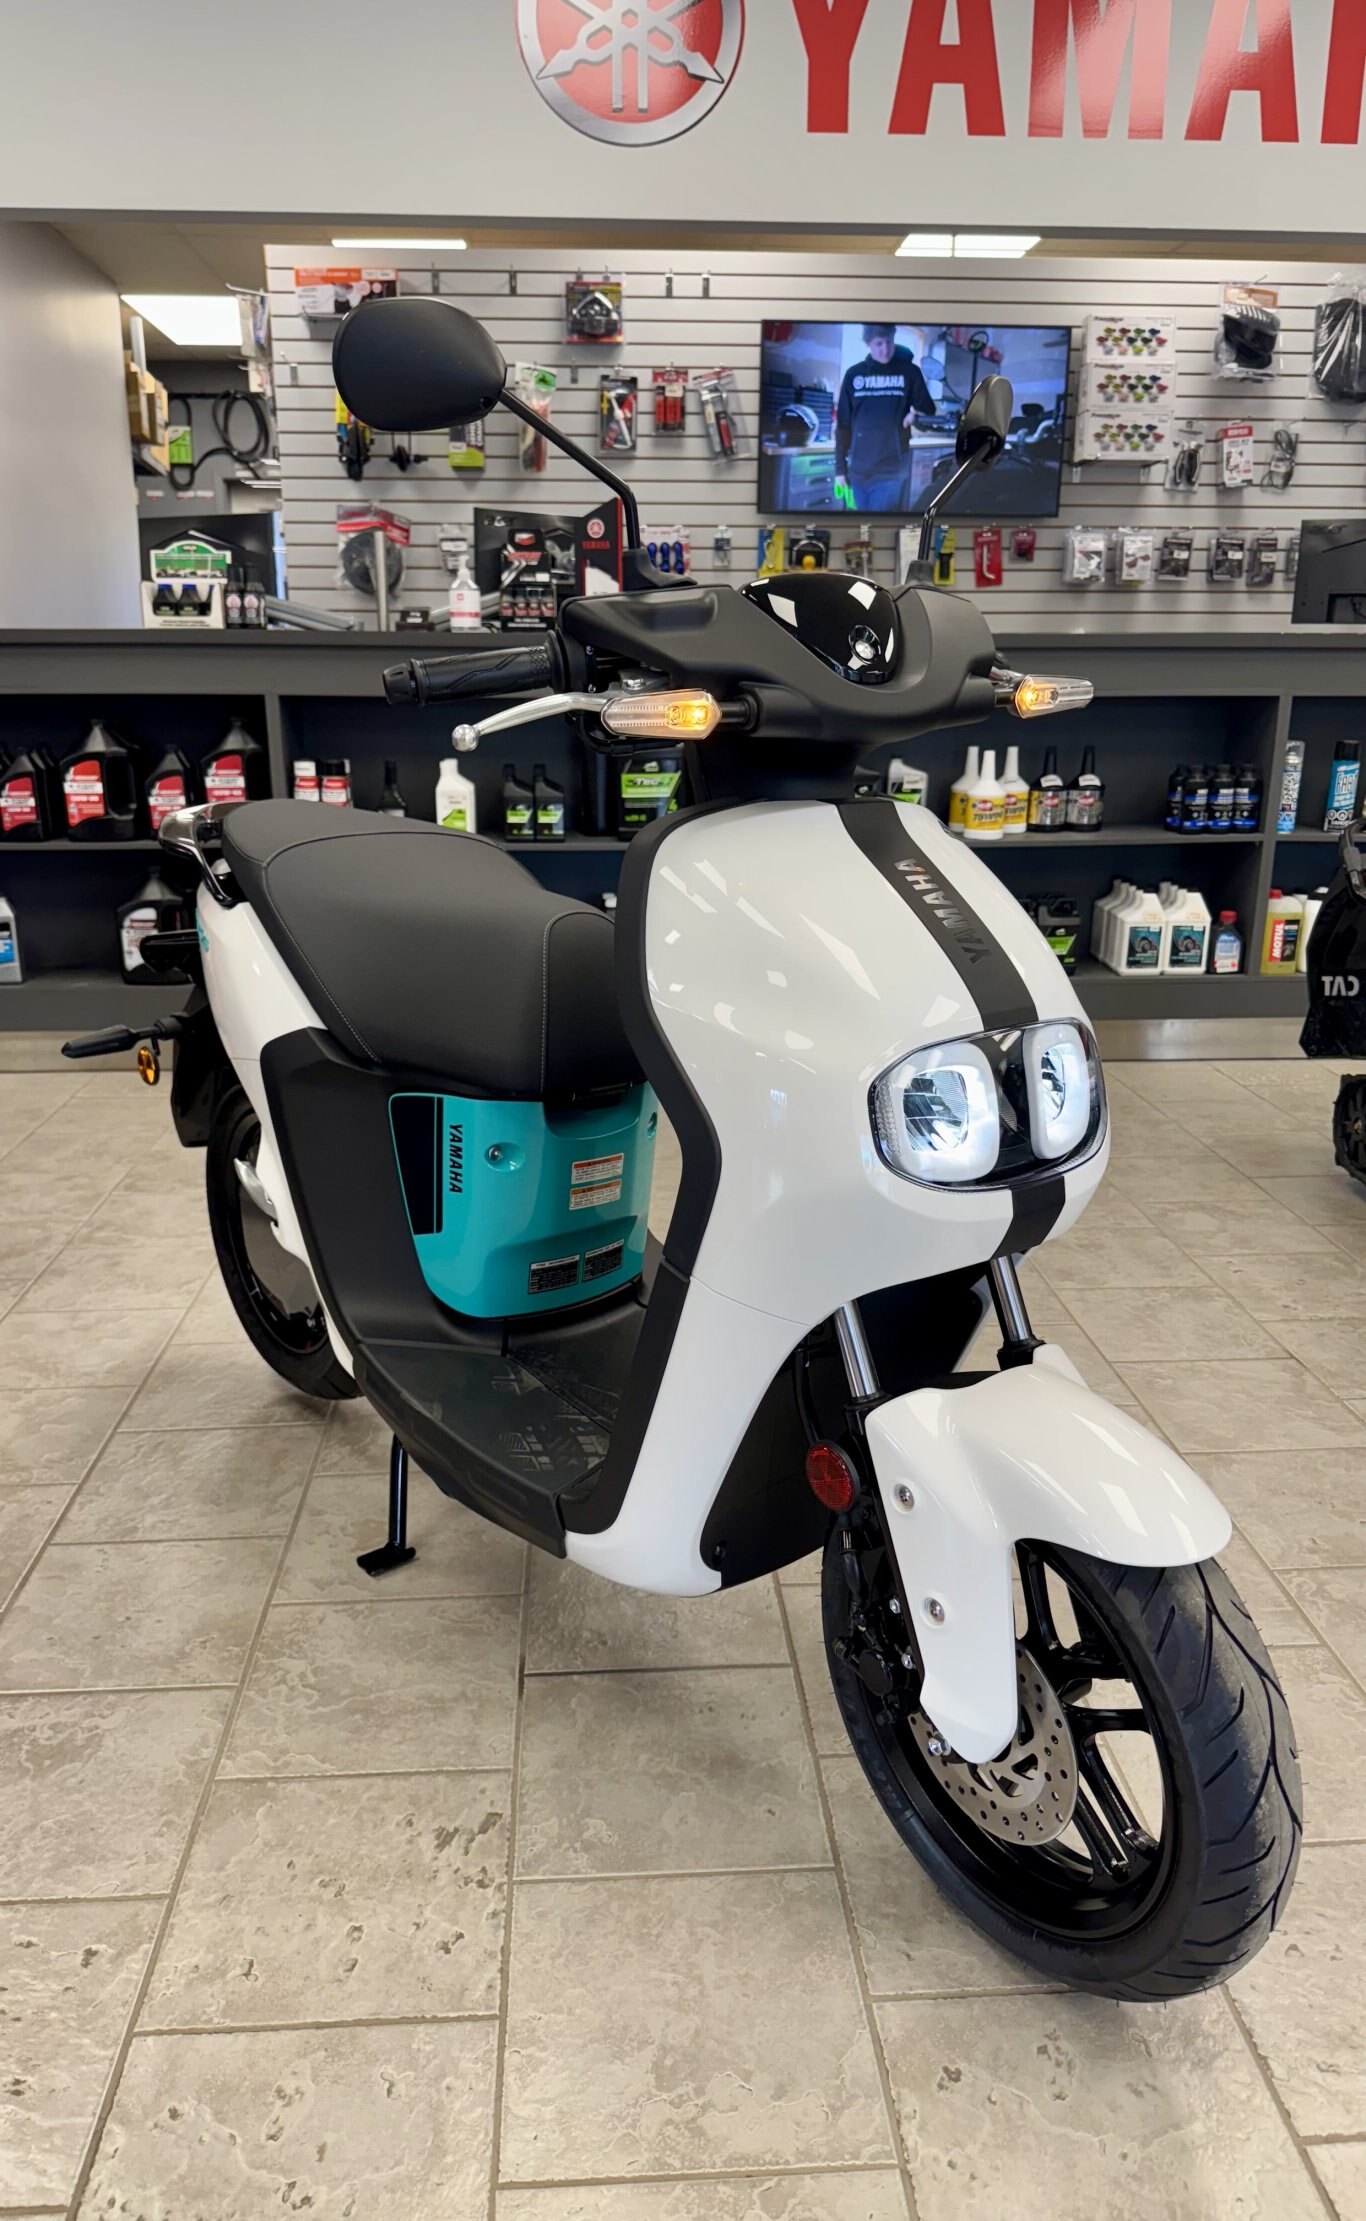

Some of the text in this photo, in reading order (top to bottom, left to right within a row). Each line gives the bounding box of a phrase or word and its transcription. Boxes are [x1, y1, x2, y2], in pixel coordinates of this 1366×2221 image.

[865, 374, 905, 388] YAMAHA
[894, 857, 992, 964] YAMAHA
[1271, 922, 1285, 959] MOTUL
[449, 1123, 463, 1194] YAMAHA
